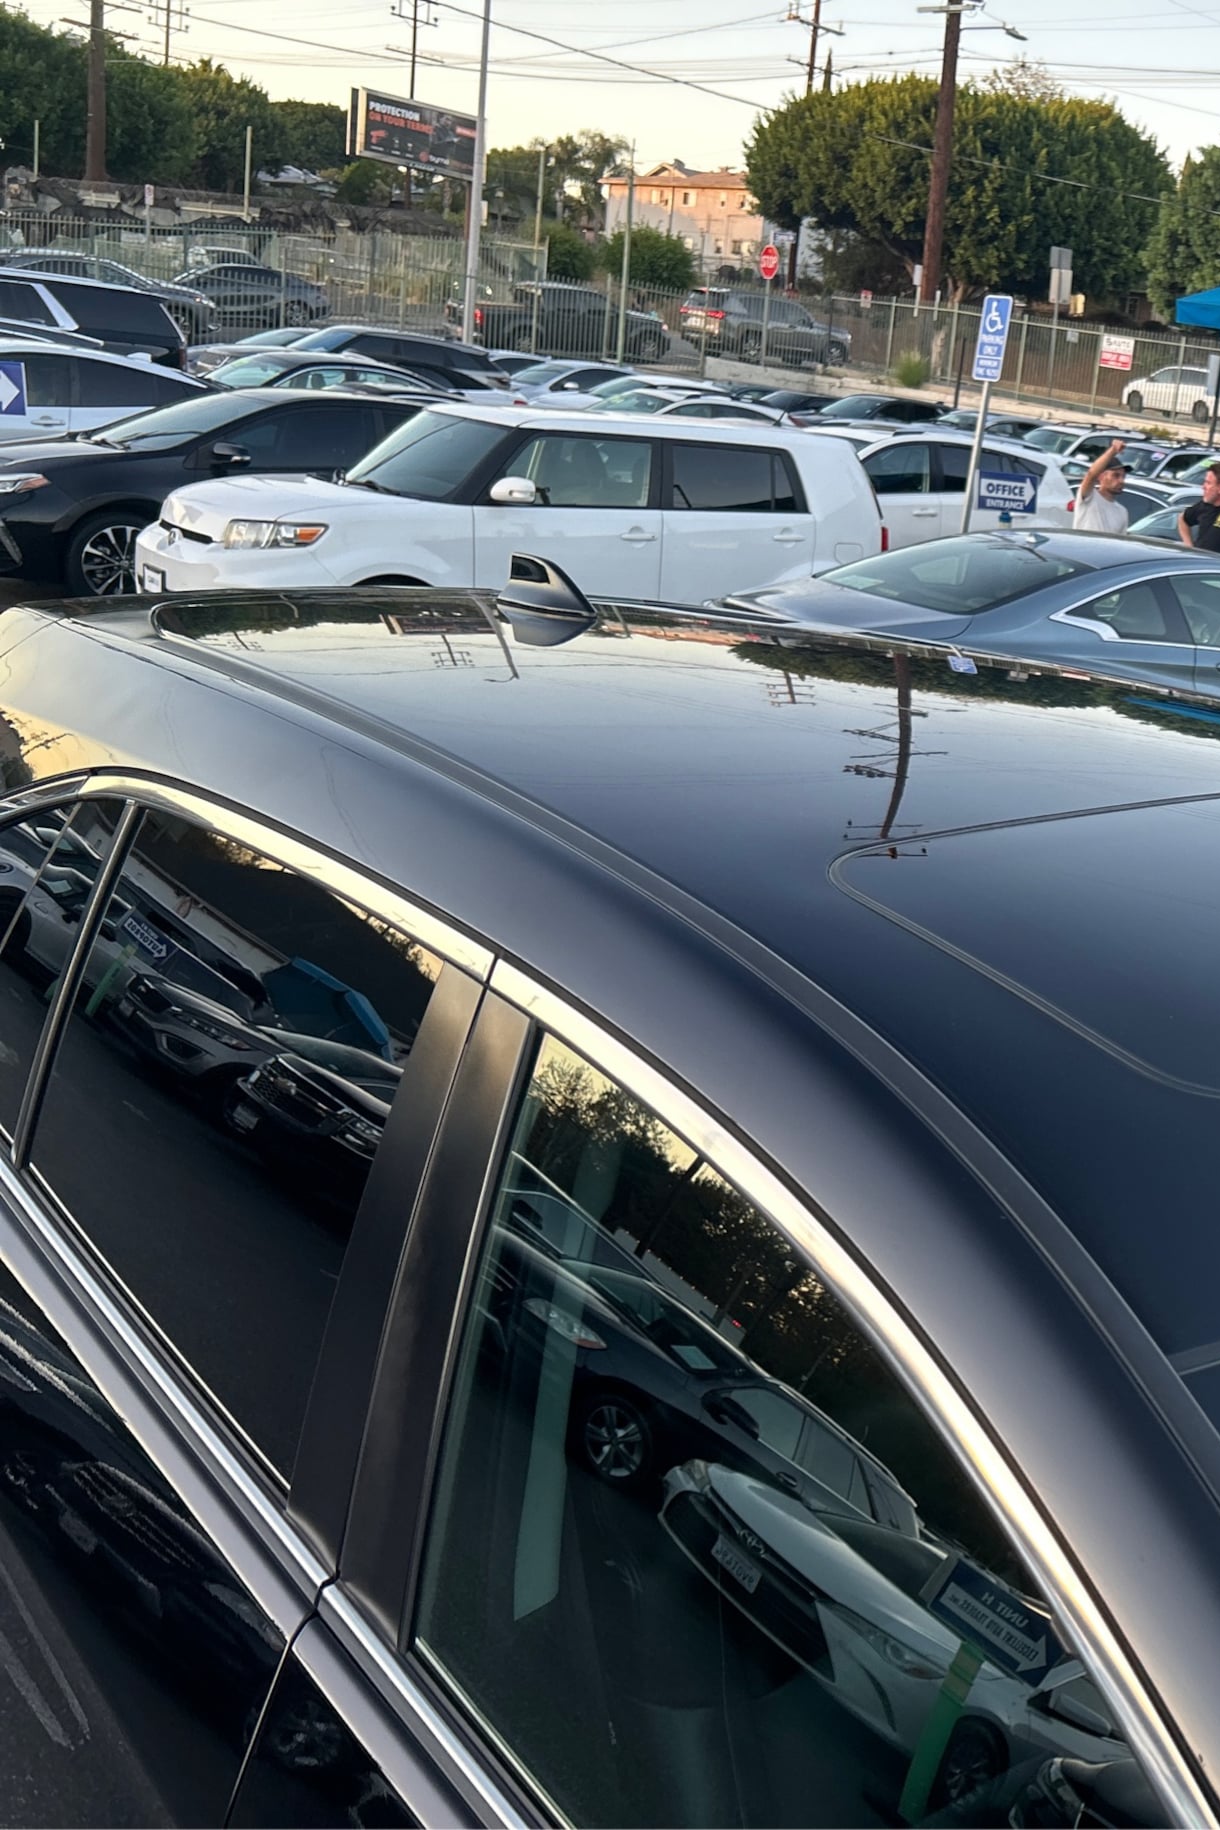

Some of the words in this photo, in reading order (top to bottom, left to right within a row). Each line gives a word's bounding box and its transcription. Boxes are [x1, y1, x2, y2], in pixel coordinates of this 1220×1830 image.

[369, 101, 420, 121] PROTECTION
[761, 255, 777, 268] STOP
[986, 483, 1025, 497] OFFICE
[986, 499, 1025, 510] ENTRANCE
